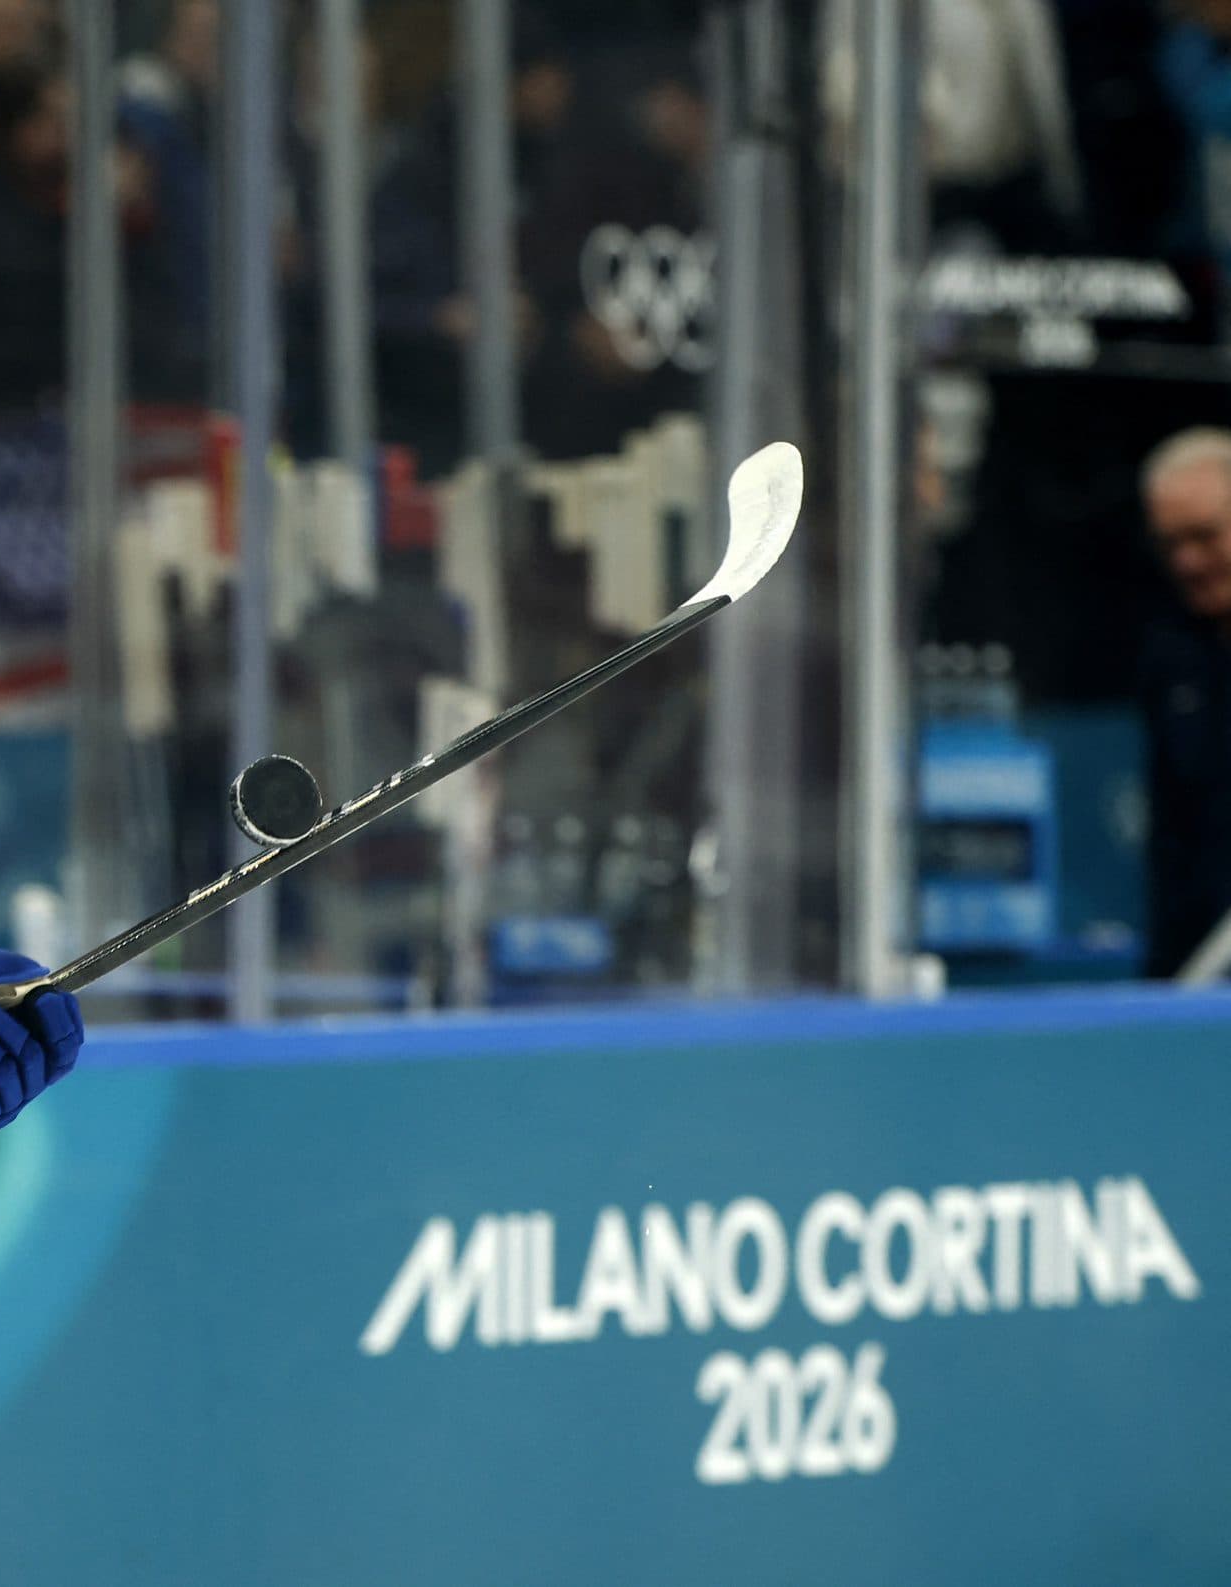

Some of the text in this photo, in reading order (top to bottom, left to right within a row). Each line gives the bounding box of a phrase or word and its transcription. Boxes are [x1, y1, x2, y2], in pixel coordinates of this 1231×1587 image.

[361, 1177, 1199, 1353] MILANO CORTINA
[695, 1343, 895, 1484] 2026
